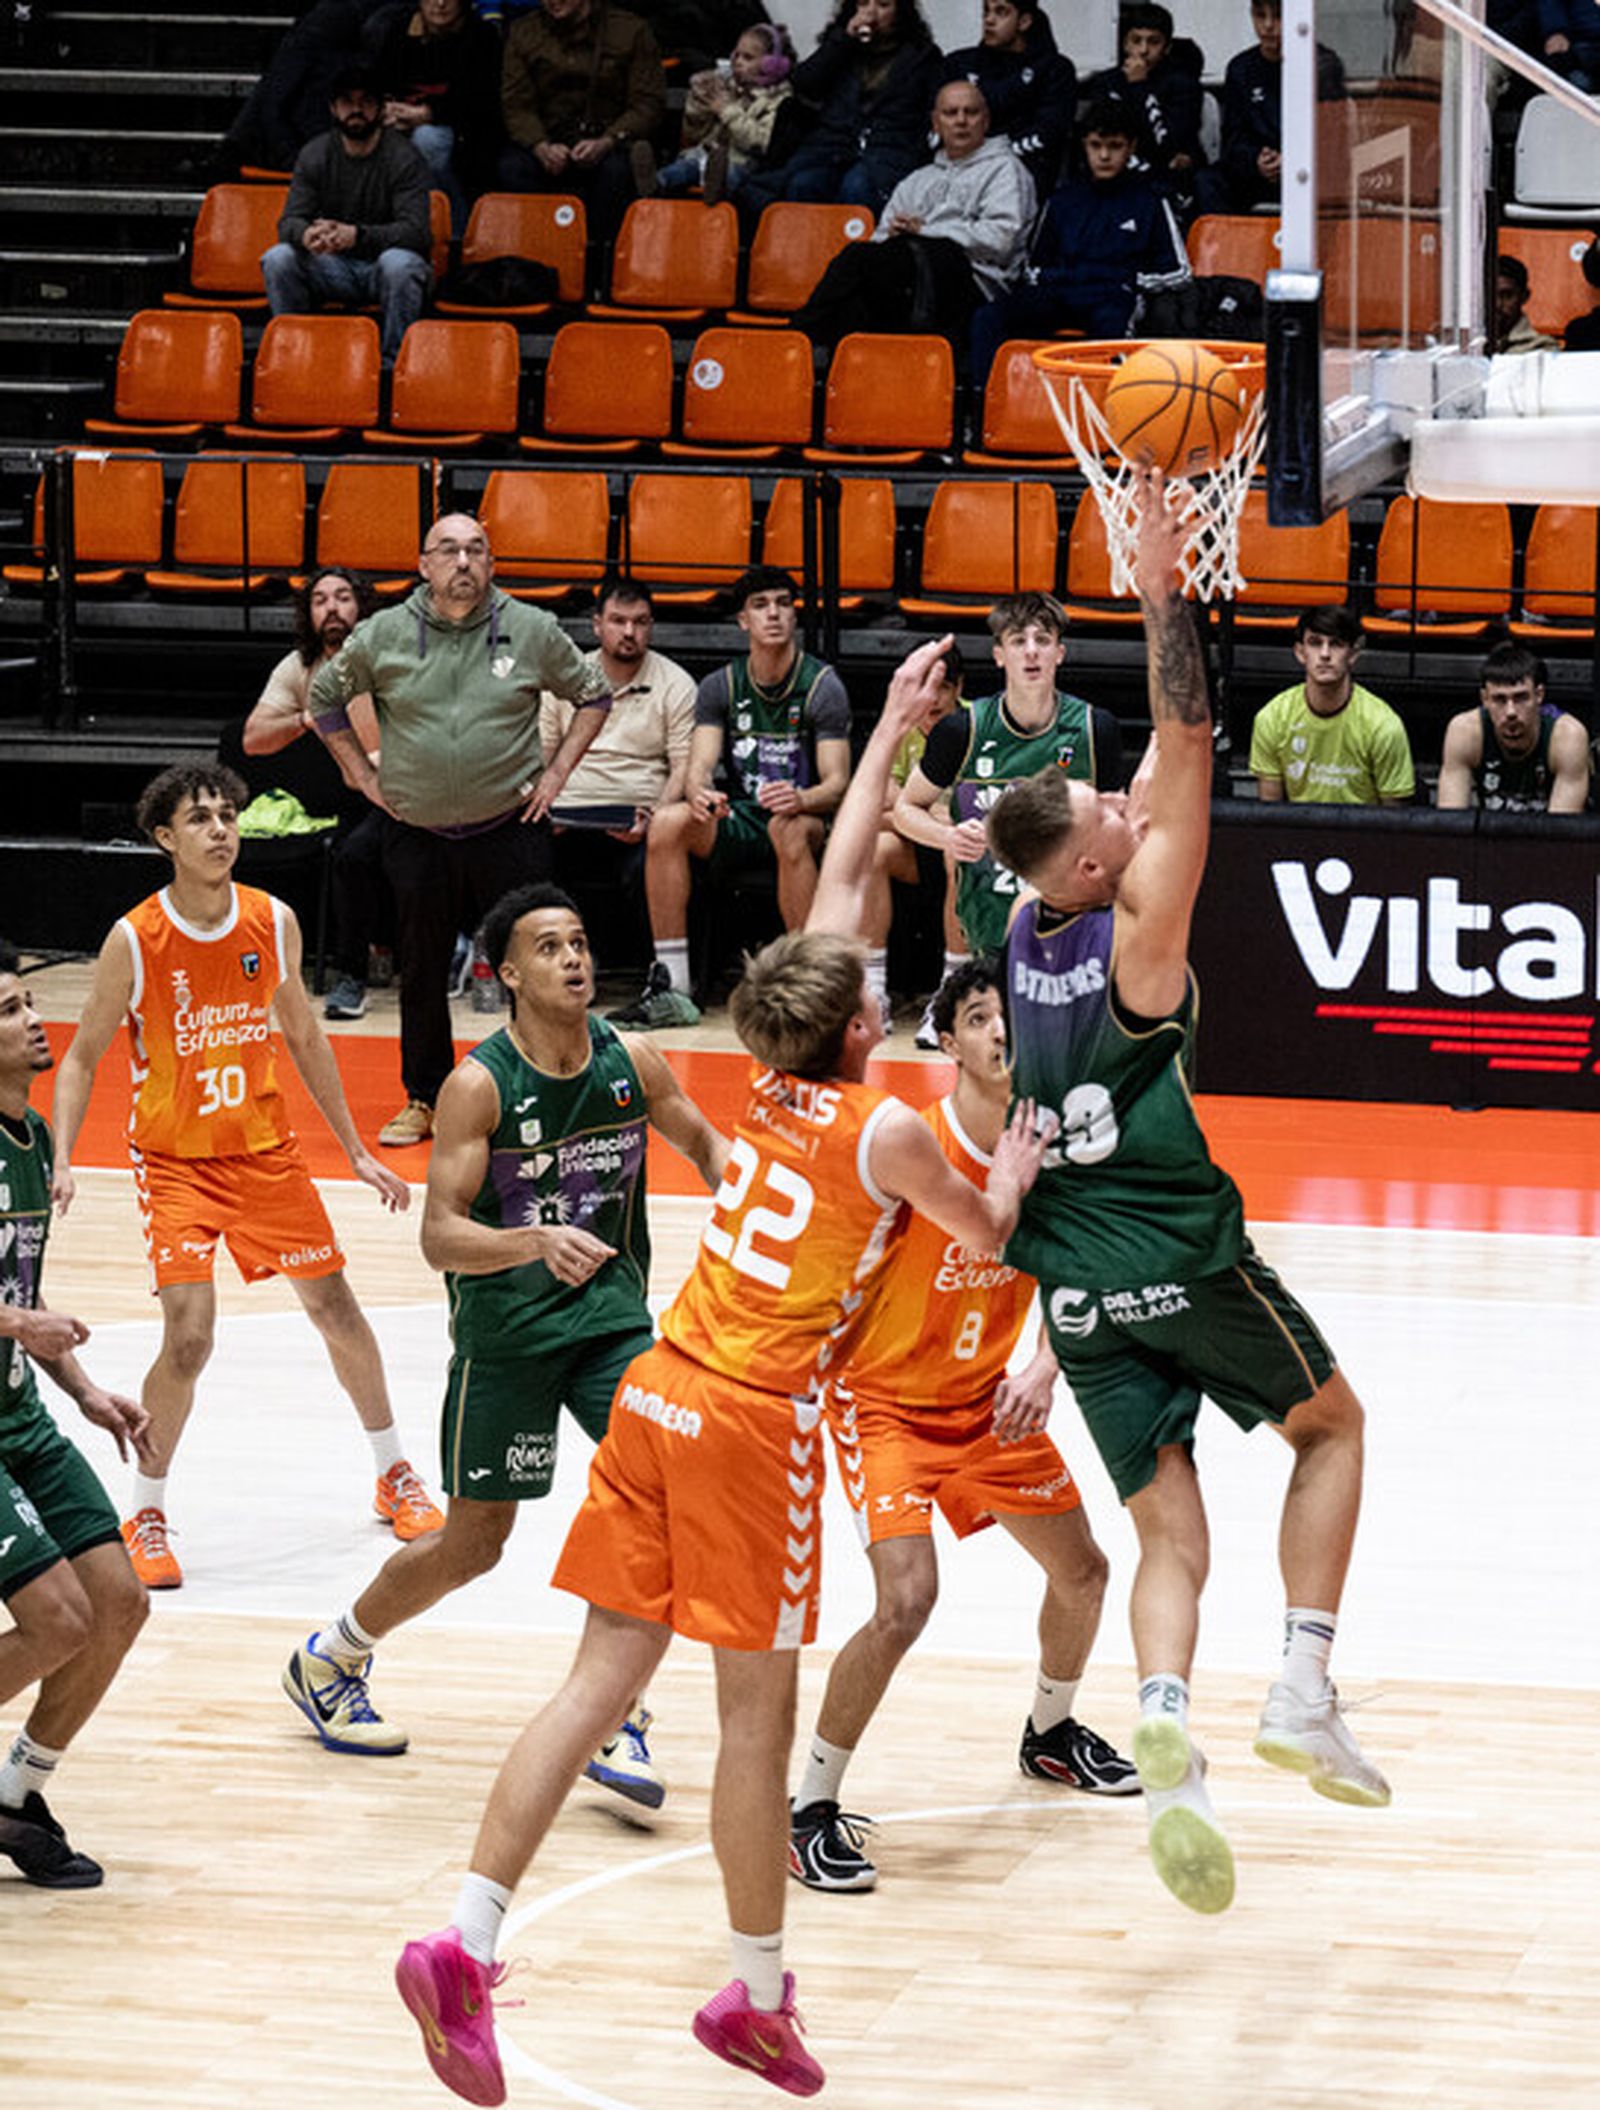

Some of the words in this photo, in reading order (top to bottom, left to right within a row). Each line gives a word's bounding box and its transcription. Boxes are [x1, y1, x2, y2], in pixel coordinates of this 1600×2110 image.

[1271, 858, 1600, 1001] Vita
[196, 1066, 246, 1116] 30
[703, 1136, 814, 1290] 22
[1101, 1291, 1142, 1311] DEL
[1141, 1283, 1186, 1303] SOL
[955, 1311, 983, 1360] 8
[618, 1385, 702, 1439] PAMESA
